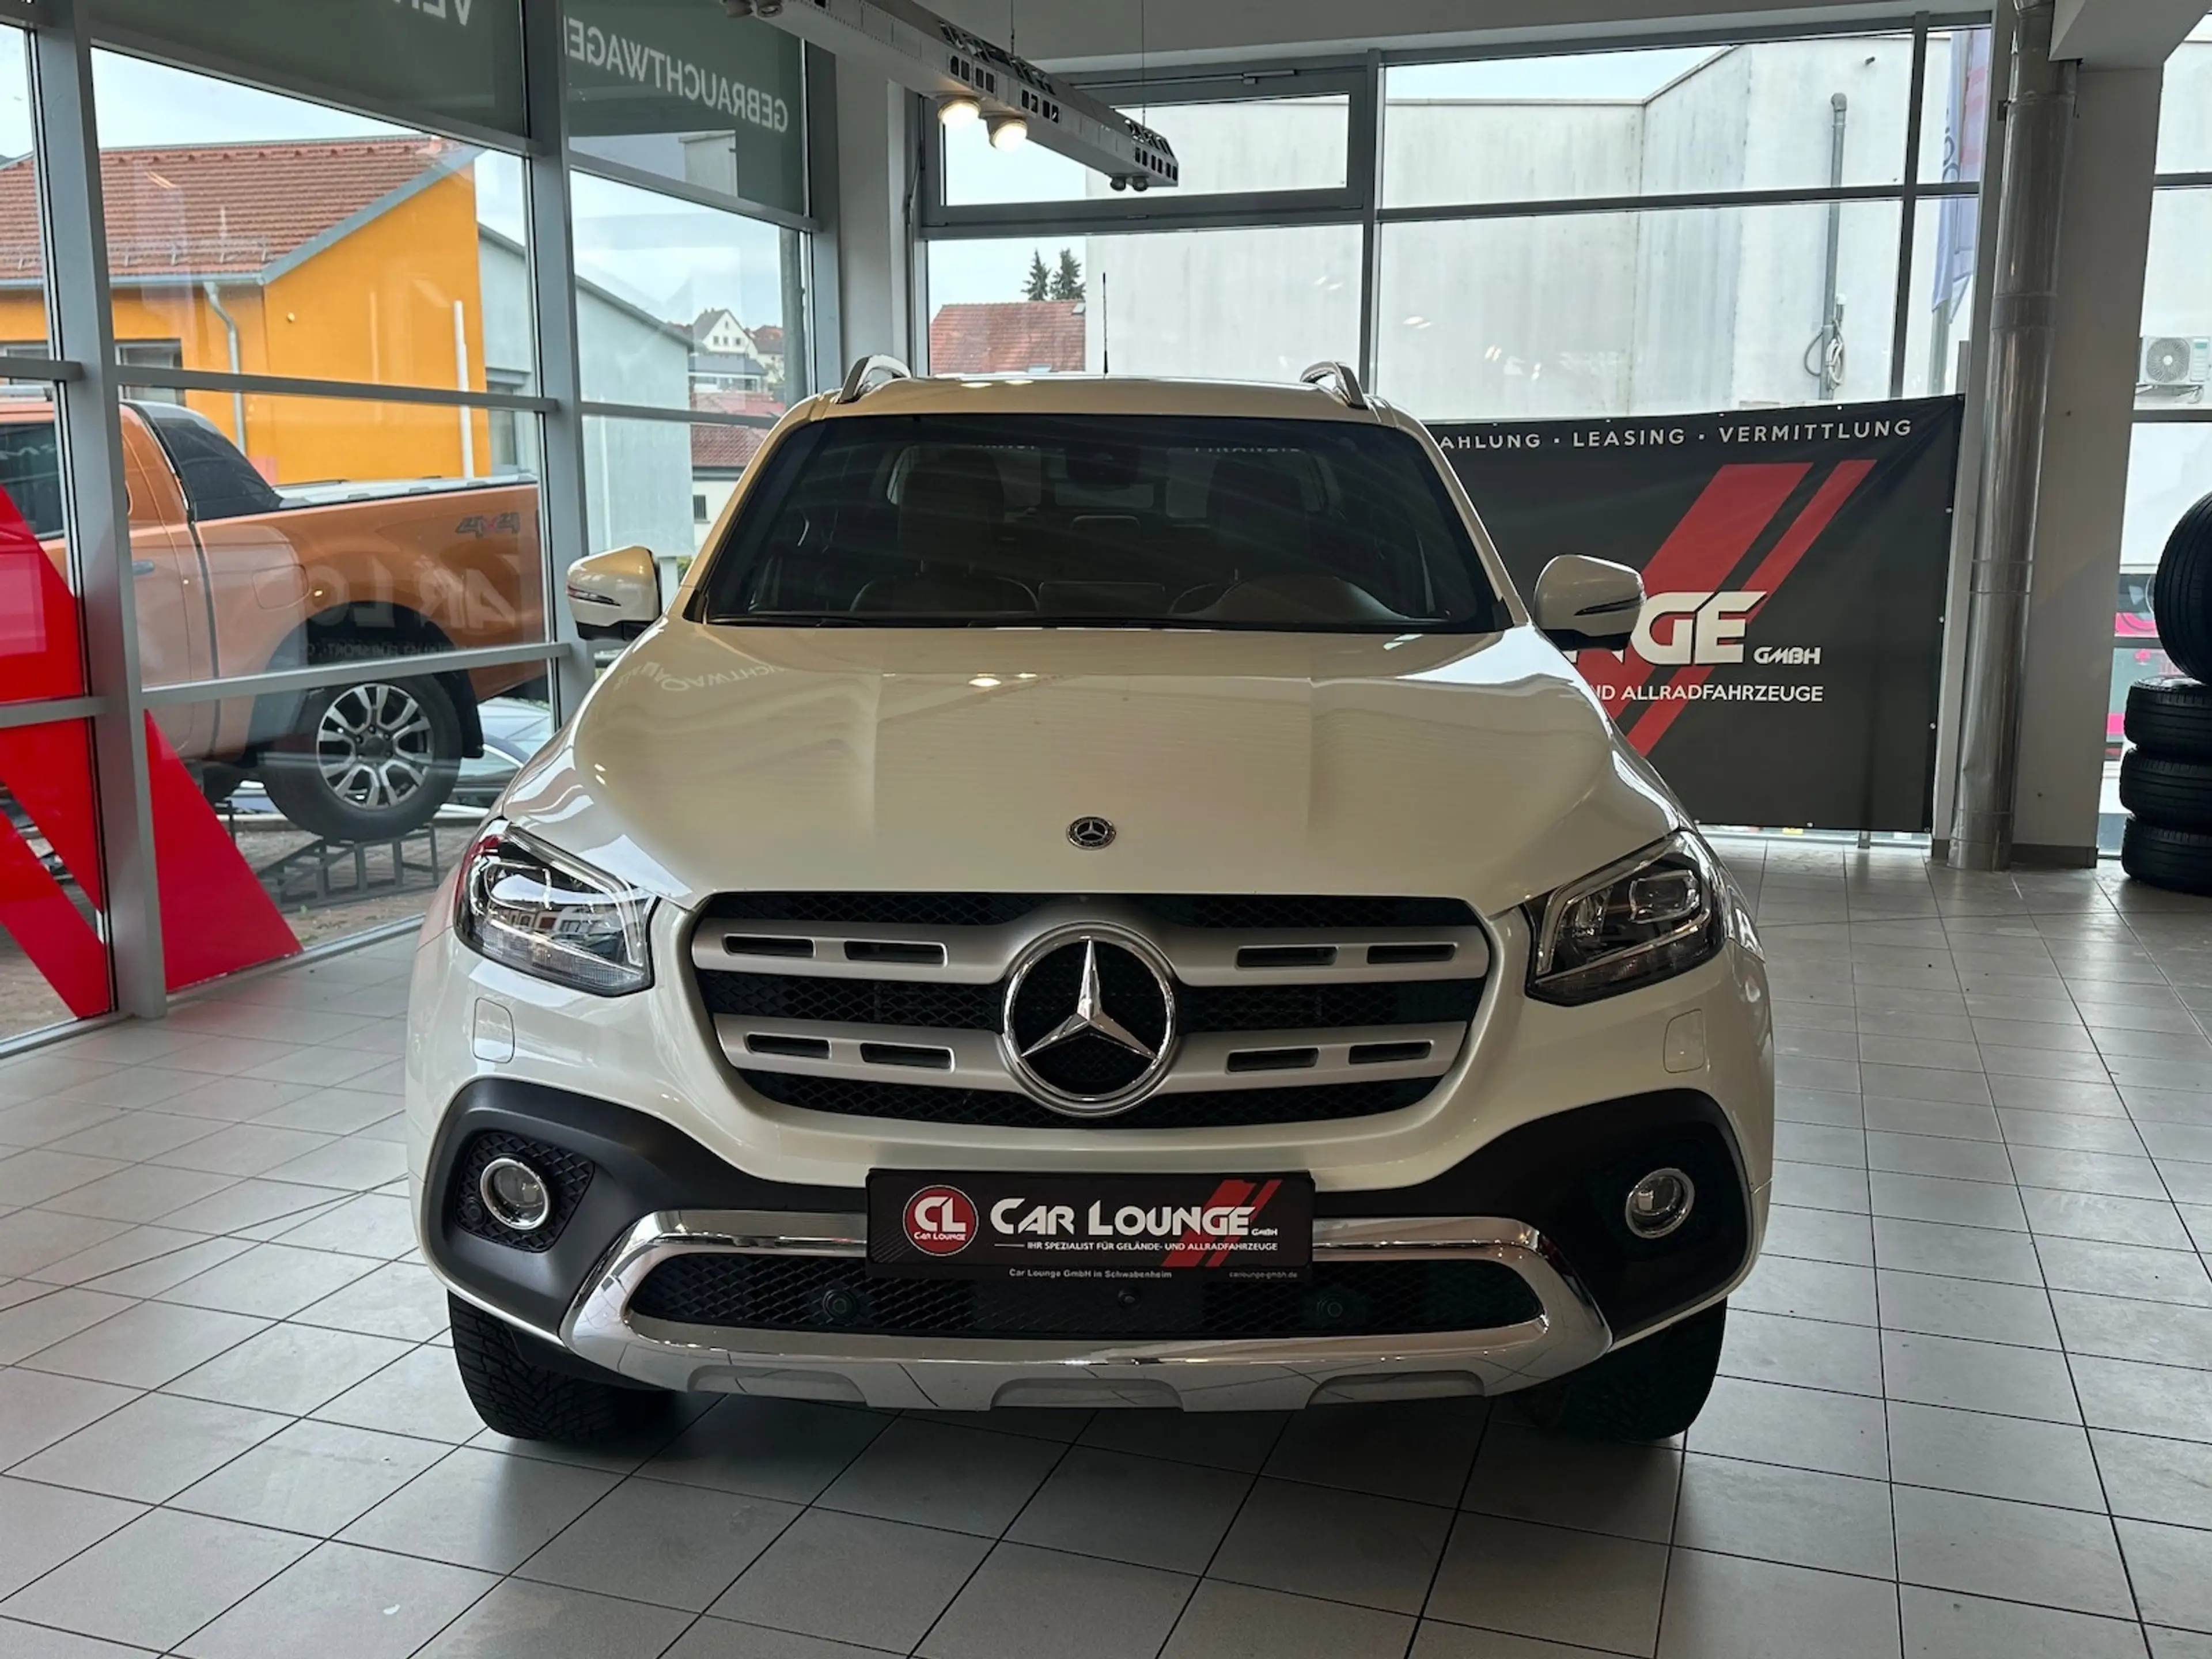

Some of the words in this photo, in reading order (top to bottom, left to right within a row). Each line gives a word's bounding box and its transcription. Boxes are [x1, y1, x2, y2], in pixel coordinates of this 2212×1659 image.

[1573, 428, 1685, 447] LEASING
[1719, 419, 1911, 443] VERMITTLUNG
[1562, 592, 1767, 665] GE
[1753, 646, 1822, 665] GMBH
[1620, 684, 1824, 702] ALLRADFAHRZEUGE
[914, 1196, 967, 1232] CL
[990, 1198, 1075, 1235] CAR
[1088, 1199, 1256, 1236] LOUNGE
[1027, 1241, 1043, 1249] IHR
[1044, 1241, 1093, 1250] SPEZIALIST
[1096, 1240, 1115, 1250] FÜR
[1116, 1240, 1162, 1251] GELÄNDE-
[1165, 1243, 1185, 1251] UND
[1187, 1243, 1278, 1251] ALLRADFAHRZEUGE
[1009, 1268, 1024, 1277] Car
[1027, 1269, 1060, 1279] Lounge
[1063, 1269, 1092, 1278] GmbH
[1093, 1269, 1103, 1278] in
[1104, 1270, 1172, 1279] Schwabenheim
